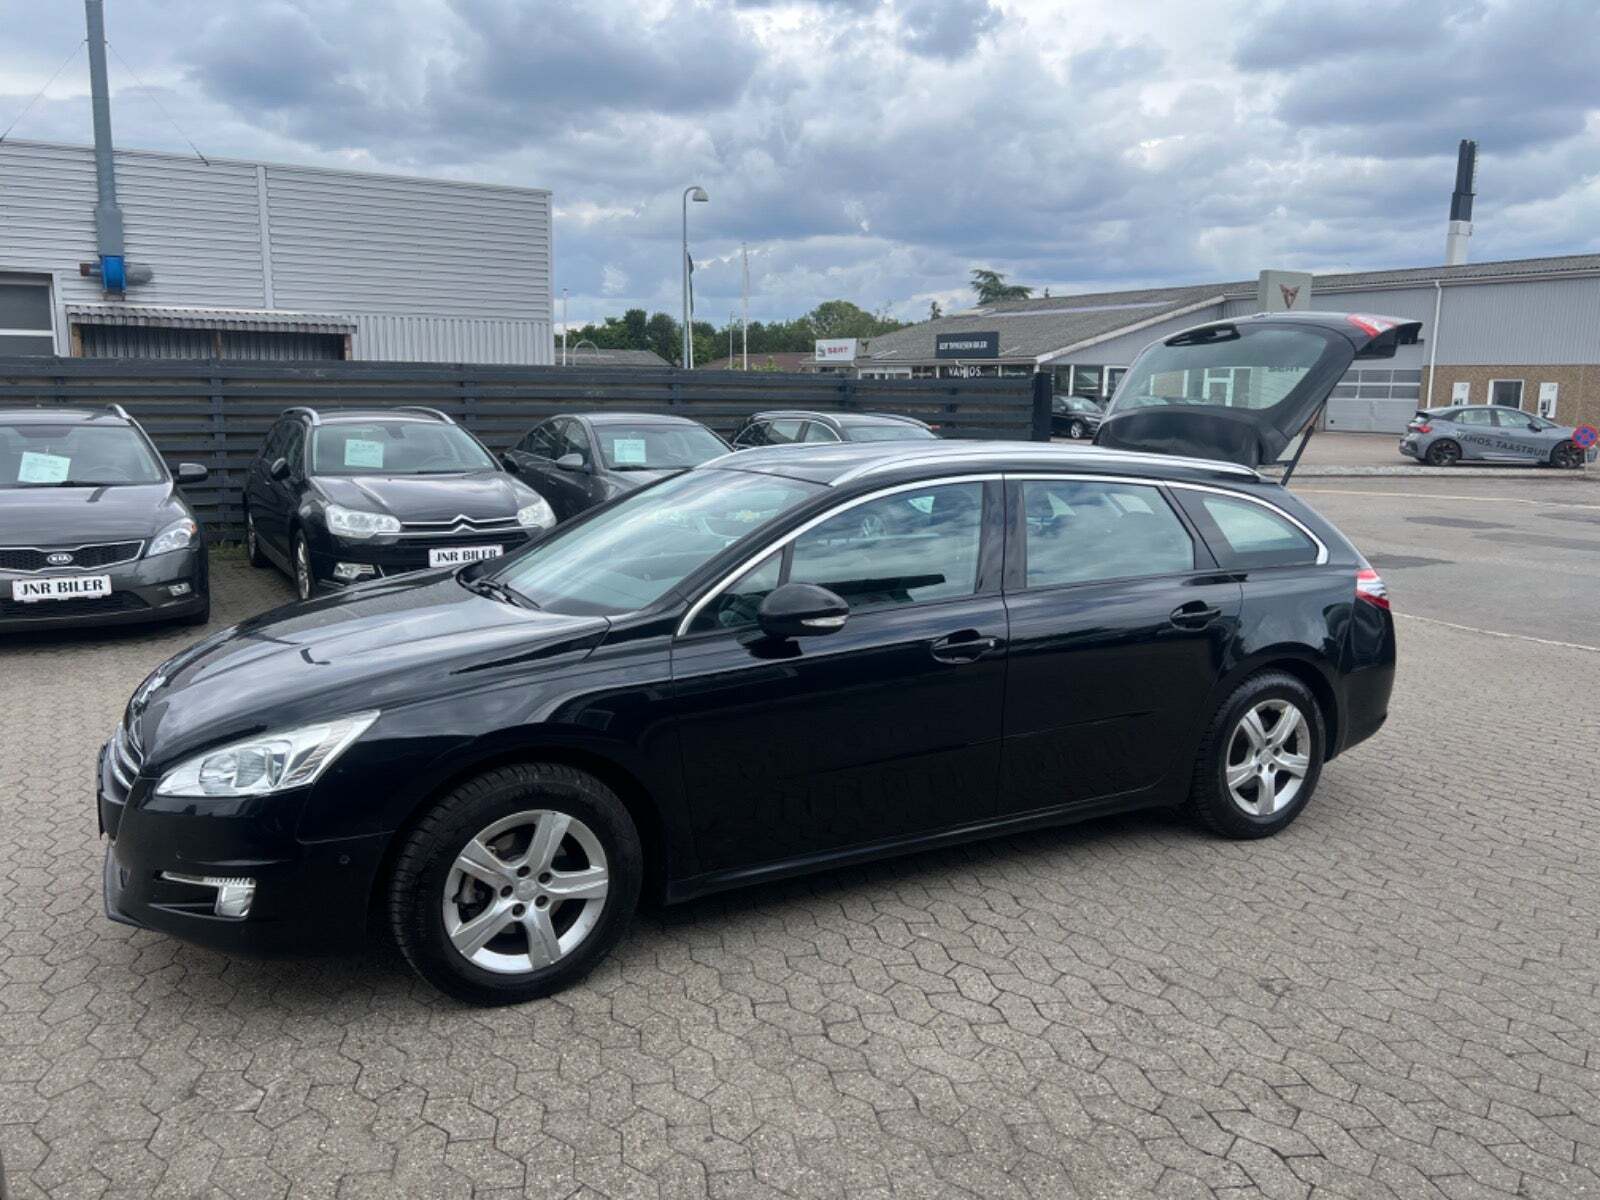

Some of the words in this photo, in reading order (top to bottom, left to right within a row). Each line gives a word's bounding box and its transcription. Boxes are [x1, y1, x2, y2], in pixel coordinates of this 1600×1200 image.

[436, 551, 458, 562] JNR
[463, 549, 496, 561] BILER
[23, 582, 51, 595] JNR
[57, 579, 102, 593] BILER
